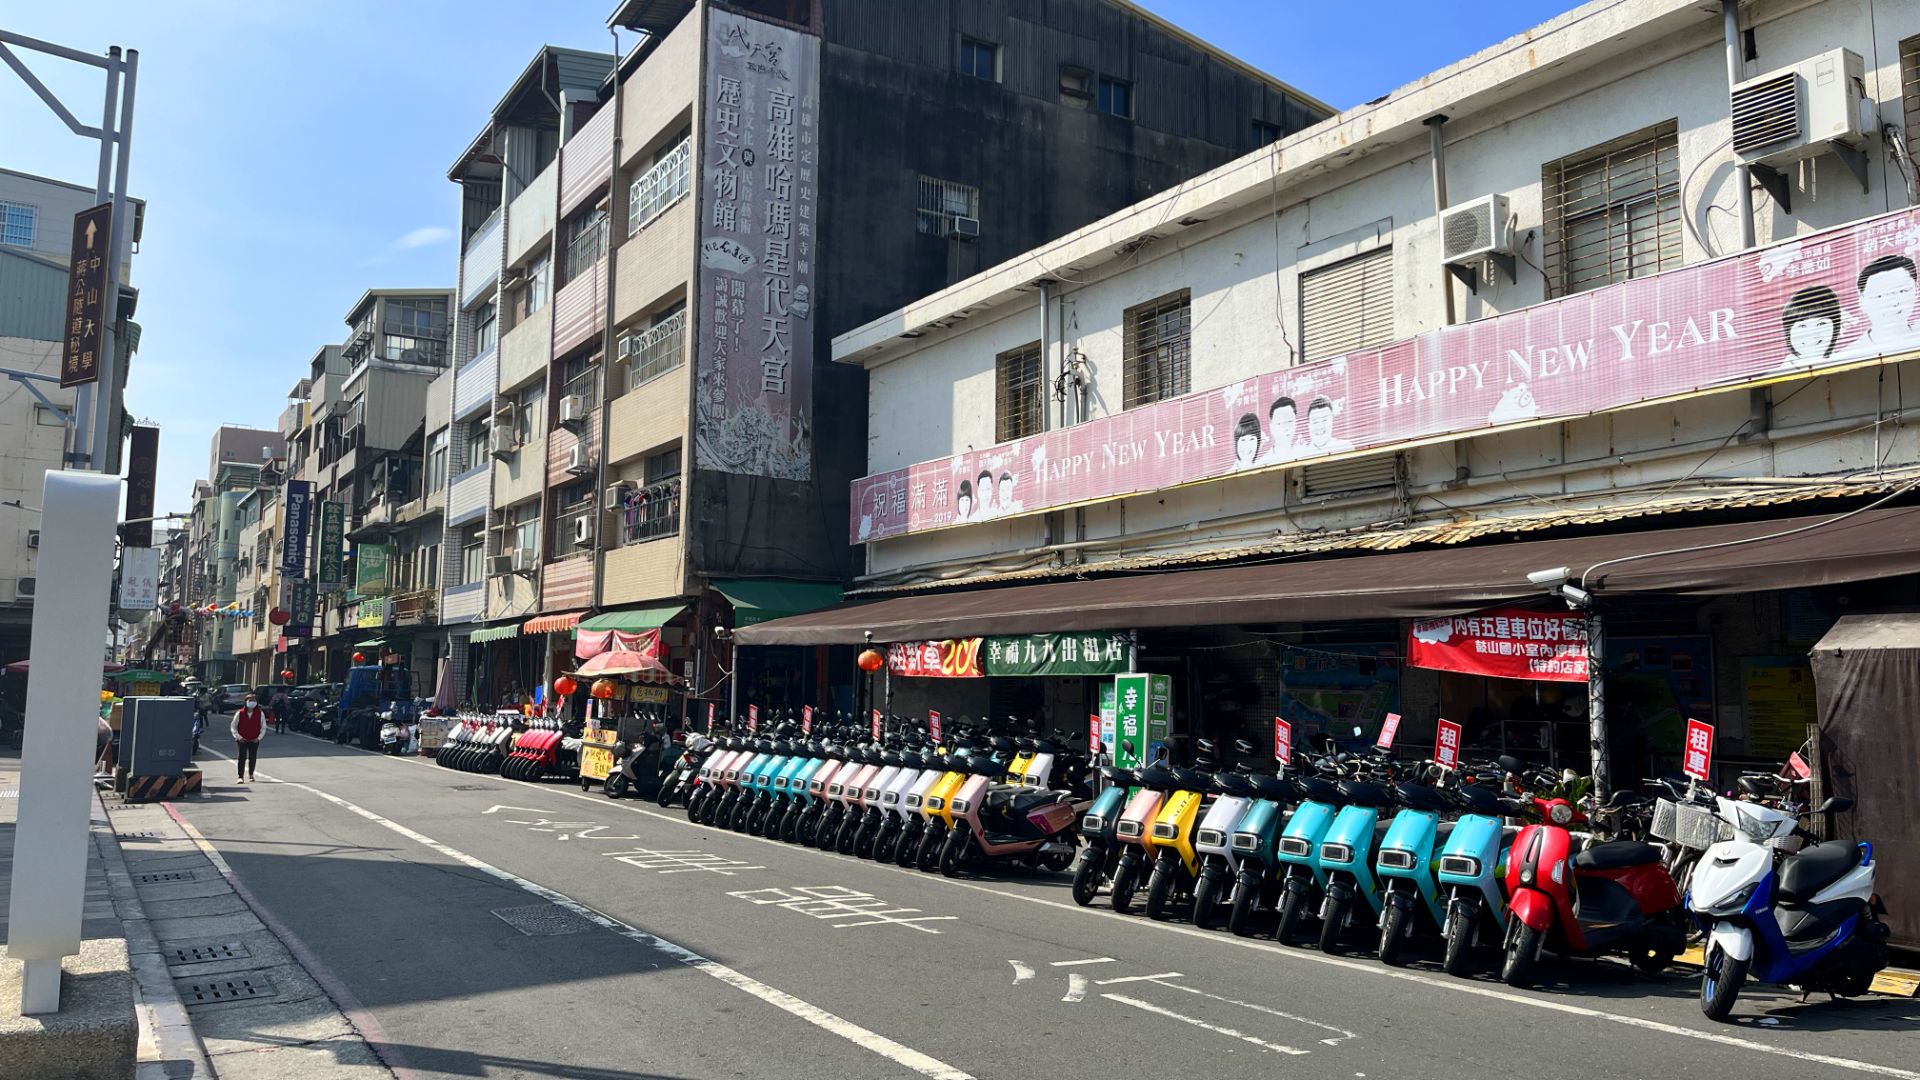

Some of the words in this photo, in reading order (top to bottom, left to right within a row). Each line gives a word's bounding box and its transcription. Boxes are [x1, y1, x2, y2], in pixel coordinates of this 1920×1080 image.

[712, 74, 742, 233] 歷史文物館
[761, 87, 796, 394] 高雄哈瑪星代天宮
[81, 255, 101, 371] 中山大學
[1379, 360, 1489, 410] HAPPY
[1506, 338, 1595, 385] NEW
[1610, 307, 1740, 362] YEAR
[1034, 452, 1095, 485] HAPPY
[1101, 439, 1148, 470] NEW
[1154, 424, 1216, 459] YEAR
[873, 478, 949, 518] 祝福滿滿
[933, 511, 953, 524] 2019
[287, 493, 305, 565] Panasonic
[989, 637, 1123, 665] 幸福九九出租店
[1277, 724, 1289, 760] 租車
[1380, 718, 1398, 744] 租車
[1439, 726, 1457, 766] 租車
[1687, 727, 1709, 773] 租車
